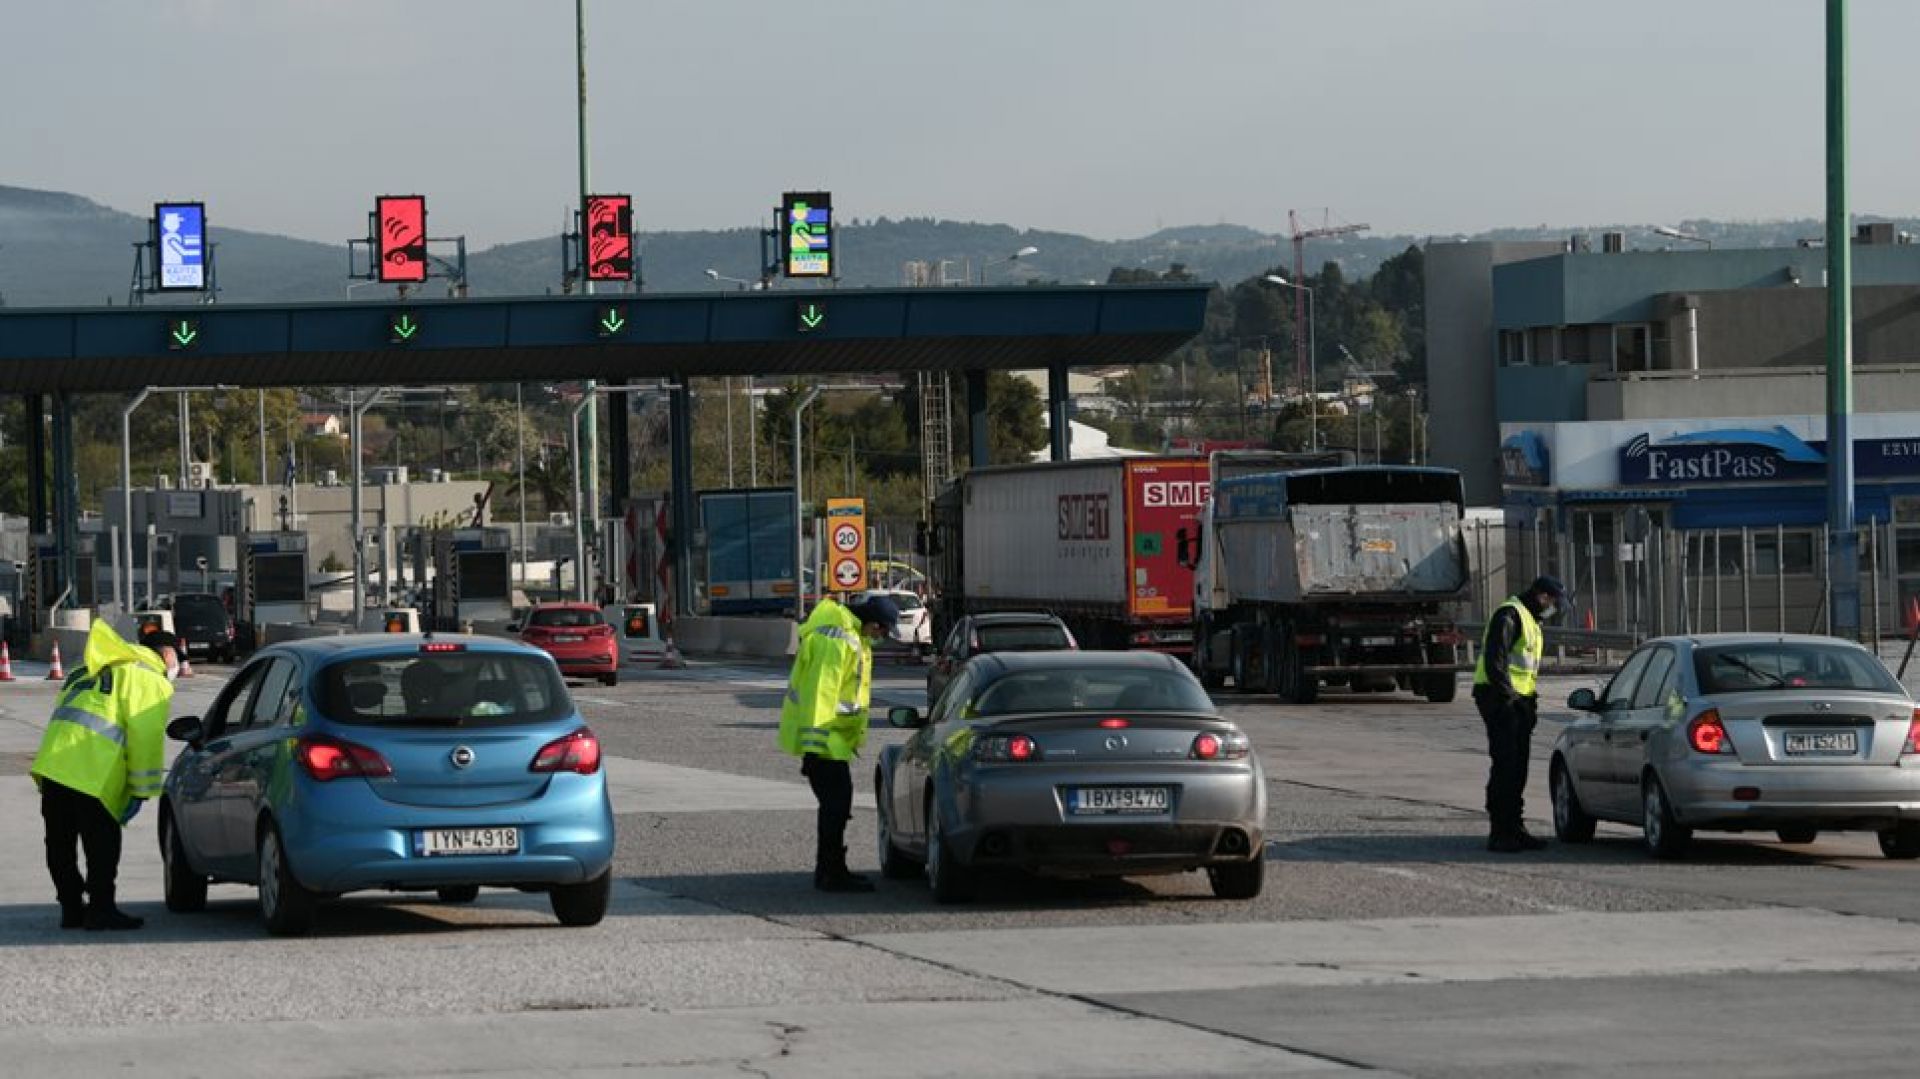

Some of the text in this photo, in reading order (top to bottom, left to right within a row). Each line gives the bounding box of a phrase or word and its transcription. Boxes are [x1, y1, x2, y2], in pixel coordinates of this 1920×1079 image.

[1647, 449, 1775, 480] FastPass
[1058, 495, 1109, 540] SMET
[838, 531, 856, 545] 20
